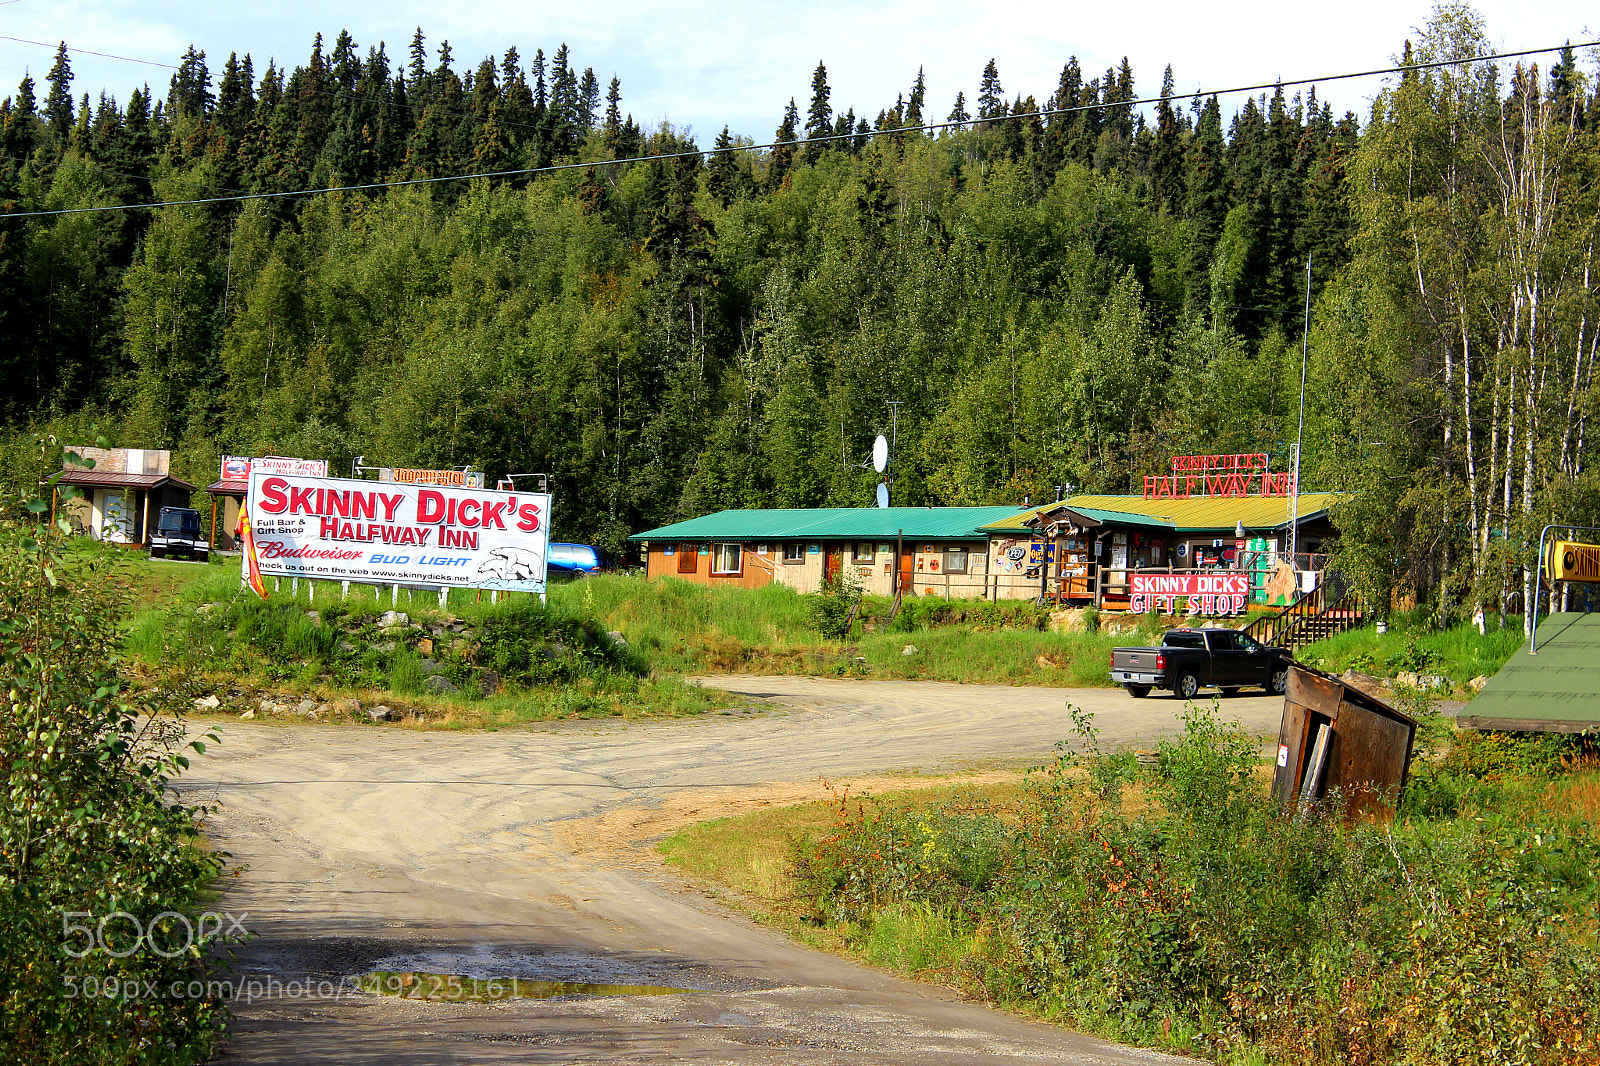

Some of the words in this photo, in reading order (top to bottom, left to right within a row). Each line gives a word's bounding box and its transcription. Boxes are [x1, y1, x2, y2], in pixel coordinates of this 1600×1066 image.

[261, 459, 293, 468] SKINNY
[1170, 455, 1221, 471] SKINNY
[1223, 453, 1267, 470] DICK'S
[1142, 475, 1199, 499] HALF
[1205, 473, 1254, 498] WAY
[258, 477, 404, 521] SKINNY
[416, 489, 541, 533] DICK'S
[257, 519, 275, 527] Full
[257, 527, 276, 535] Gift
[319, 516, 431, 547] HALFWAY
[438, 525, 479, 549] INN
[255, 540, 363, 560] Budweiser
[368, 554, 411, 565] BUD
[418, 555, 472, 567] LIGHT
[256, 561, 282, 570] heck
[299, 564, 314, 572] out
[331, 566, 346, 574] the
[349, 568, 369, 576] web
[371, 570, 469, 582] www.skinnydicks.net
[1133, 576, 1191, 593] SKINNY
[1197, 575, 1248, 593] DICK'S
[1130, 593, 1176, 614] GIFT
[1189, 594, 1245, 615] SHOP
